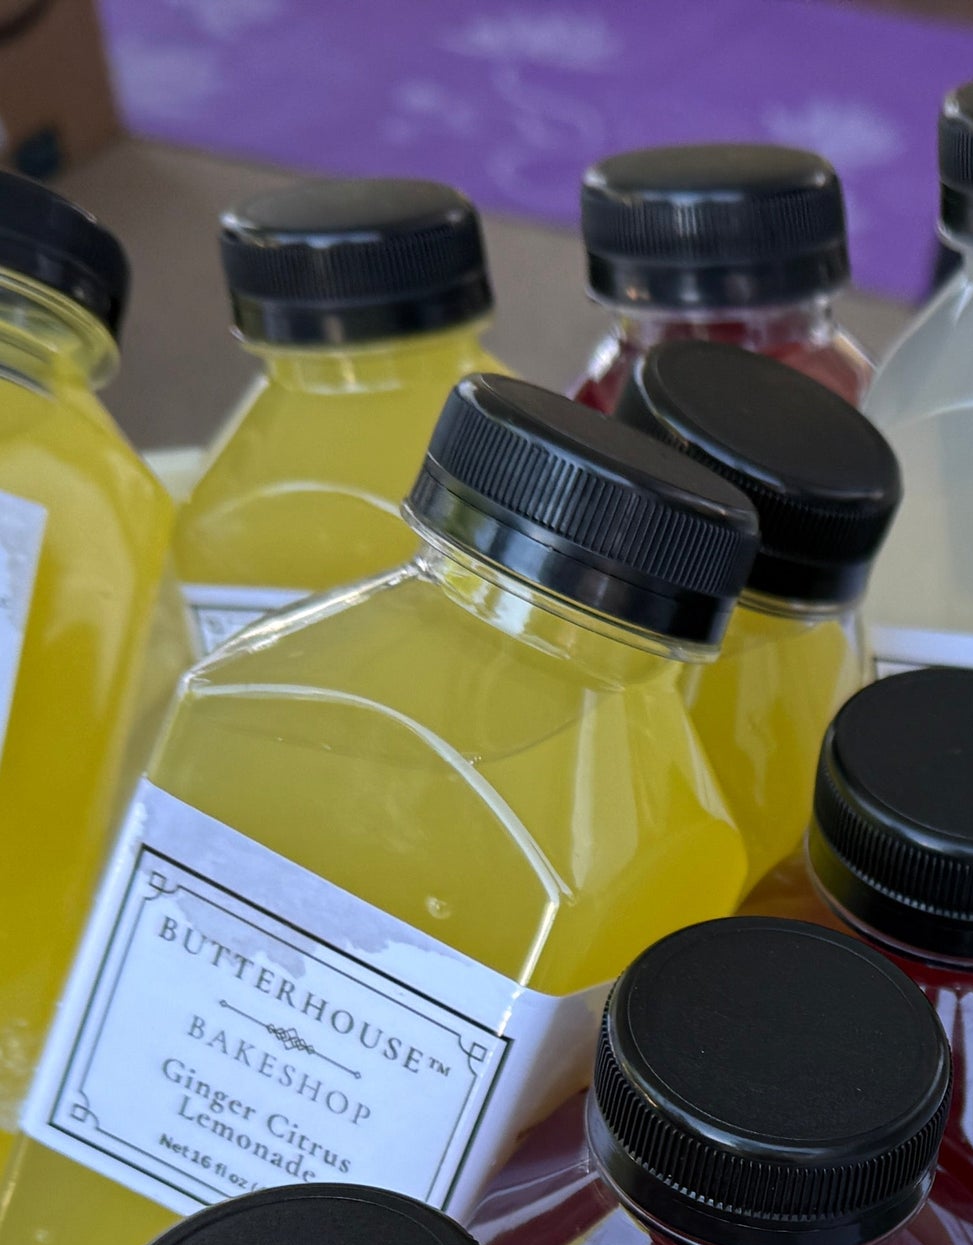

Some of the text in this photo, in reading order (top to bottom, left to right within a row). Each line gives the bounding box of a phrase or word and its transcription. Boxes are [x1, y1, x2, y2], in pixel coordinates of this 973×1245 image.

[161, 1056, 352, 1174] Ginger Citrus
[186, 1014, 372, 1127] BAKESHOP
[158, 1133, 190, 1158] Net
[190, 1151, 213, 1170] 16
[214, 1162, 229, 1179] fl
[229, 1173, 249, 1190] oz
[177, 1093, 316, 1182] Lemonade
